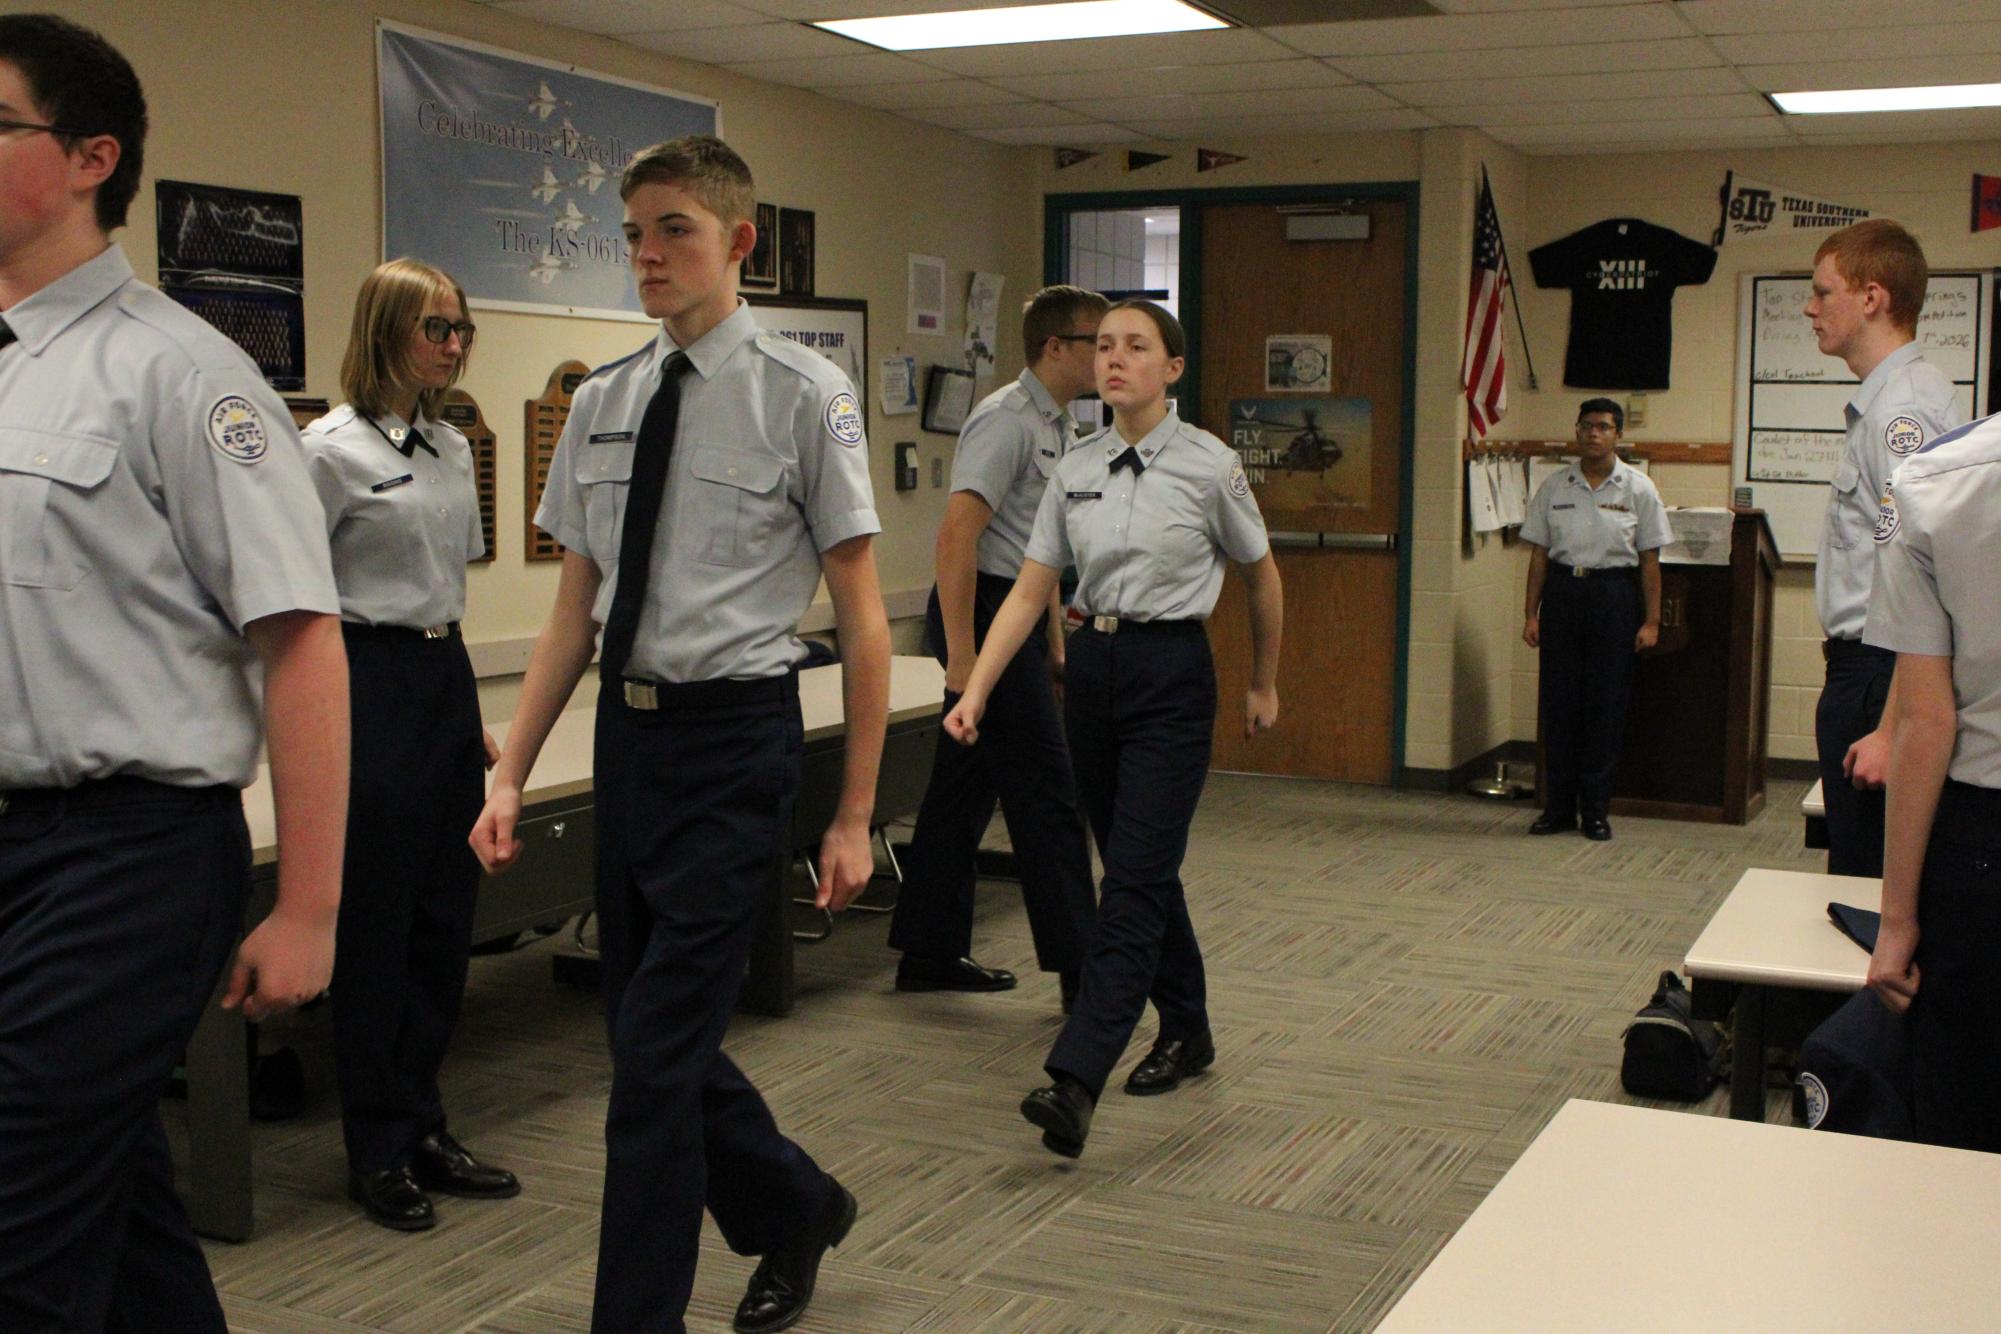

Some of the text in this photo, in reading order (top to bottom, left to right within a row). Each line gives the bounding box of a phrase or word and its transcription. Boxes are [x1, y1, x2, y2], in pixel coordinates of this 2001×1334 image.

[417, 100, 634, 167] Celebrating Excelle
[1782, 196, 1869, 218] TEXAS SOUTHERN
[1793, 215, 1855, 228] UNIVERSITY
[496, 220, 540, 254] The
[799, 331, 816, 347] TOP
[818, 331, 845, 348] STAFF
[835, 419, 860, 431] ROTC
[223, 430, 263, 446] ROTC
[1890, 436, 1919, 446] ROTC
